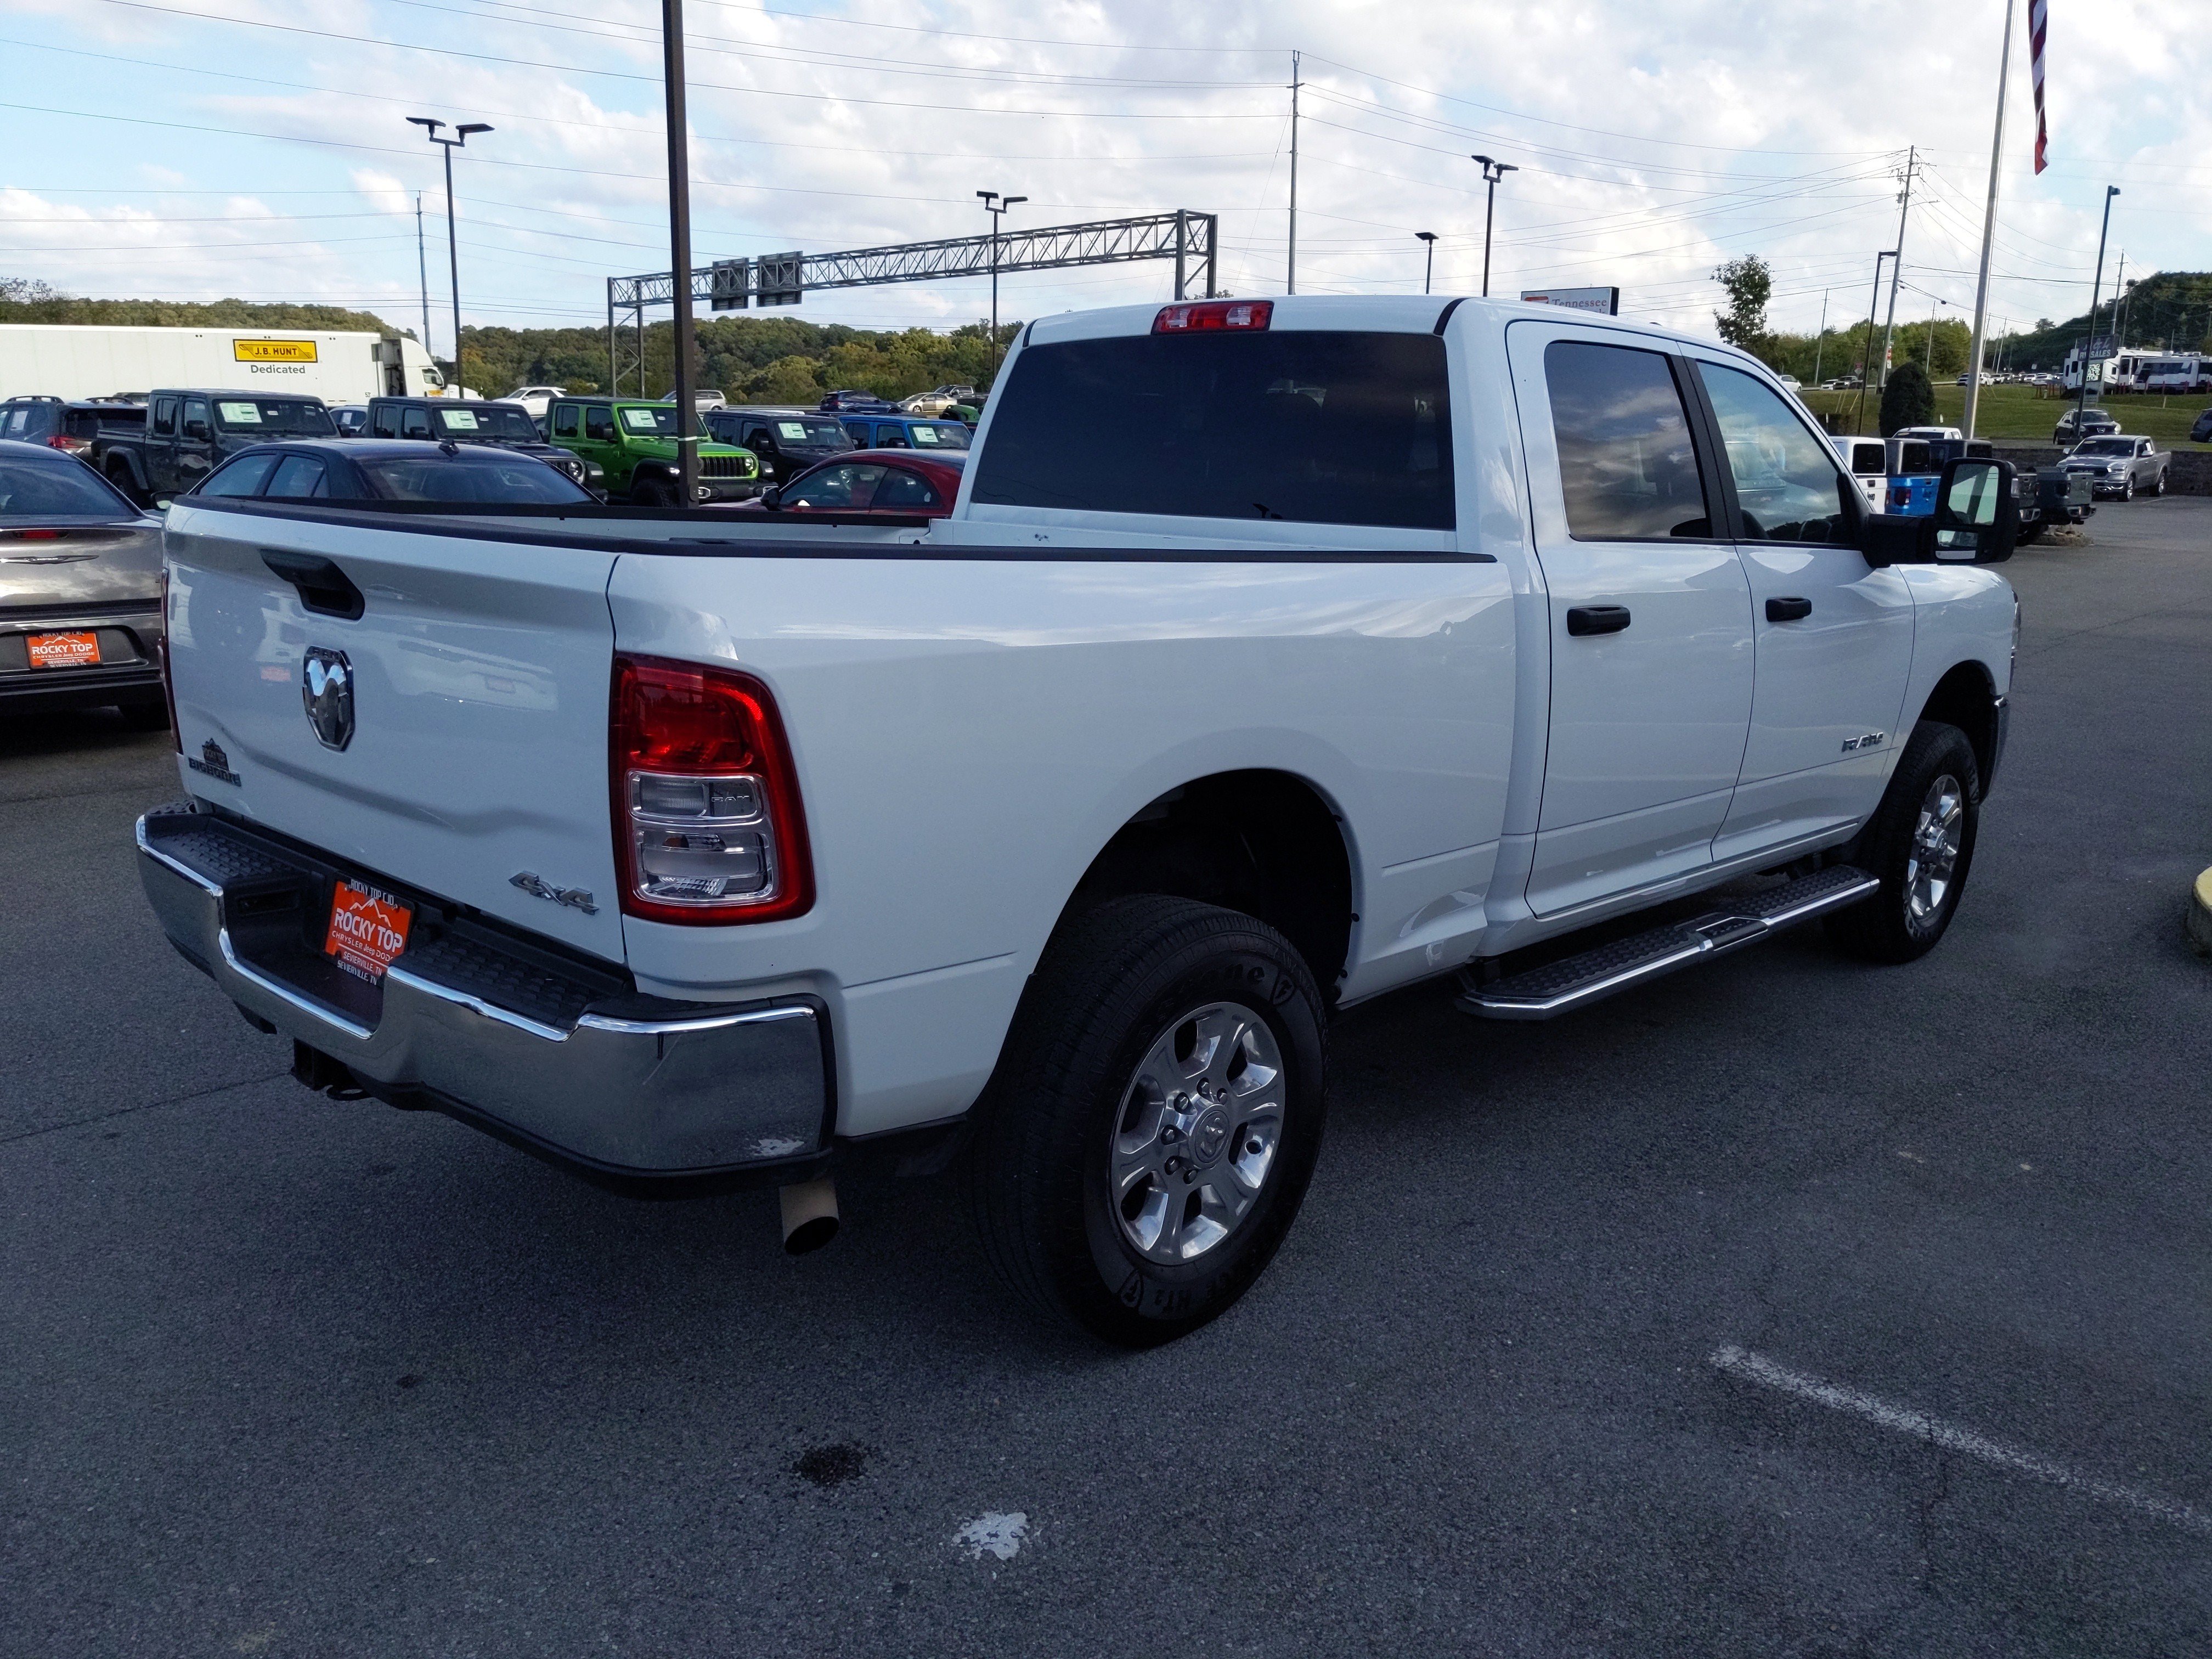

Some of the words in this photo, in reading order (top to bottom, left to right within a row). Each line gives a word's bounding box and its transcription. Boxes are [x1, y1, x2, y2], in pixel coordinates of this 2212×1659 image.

[1552, 298, 1607, 308] Tennessee
[255, 347, 271, 356] J.B.
[273, 347, 297, 356] HUNT
[2090, 349, 2111, 358] SALES
[251, 364, 306, 374] Dedicated
[32, 645, 69, 654] ROCKY
[70, 644, 93, 652] TOP
[370, 887, 381, 900] TOP
[334, 907, 376, 941] ROCKY
[377, 926, 403, 952] TOP
[332, 930, 363, 949] CHRYSLER
[363, 944, 375, 956] Jeep
[376, 950, 393, 962] DOD
[370, 975, 377, 985] TN
